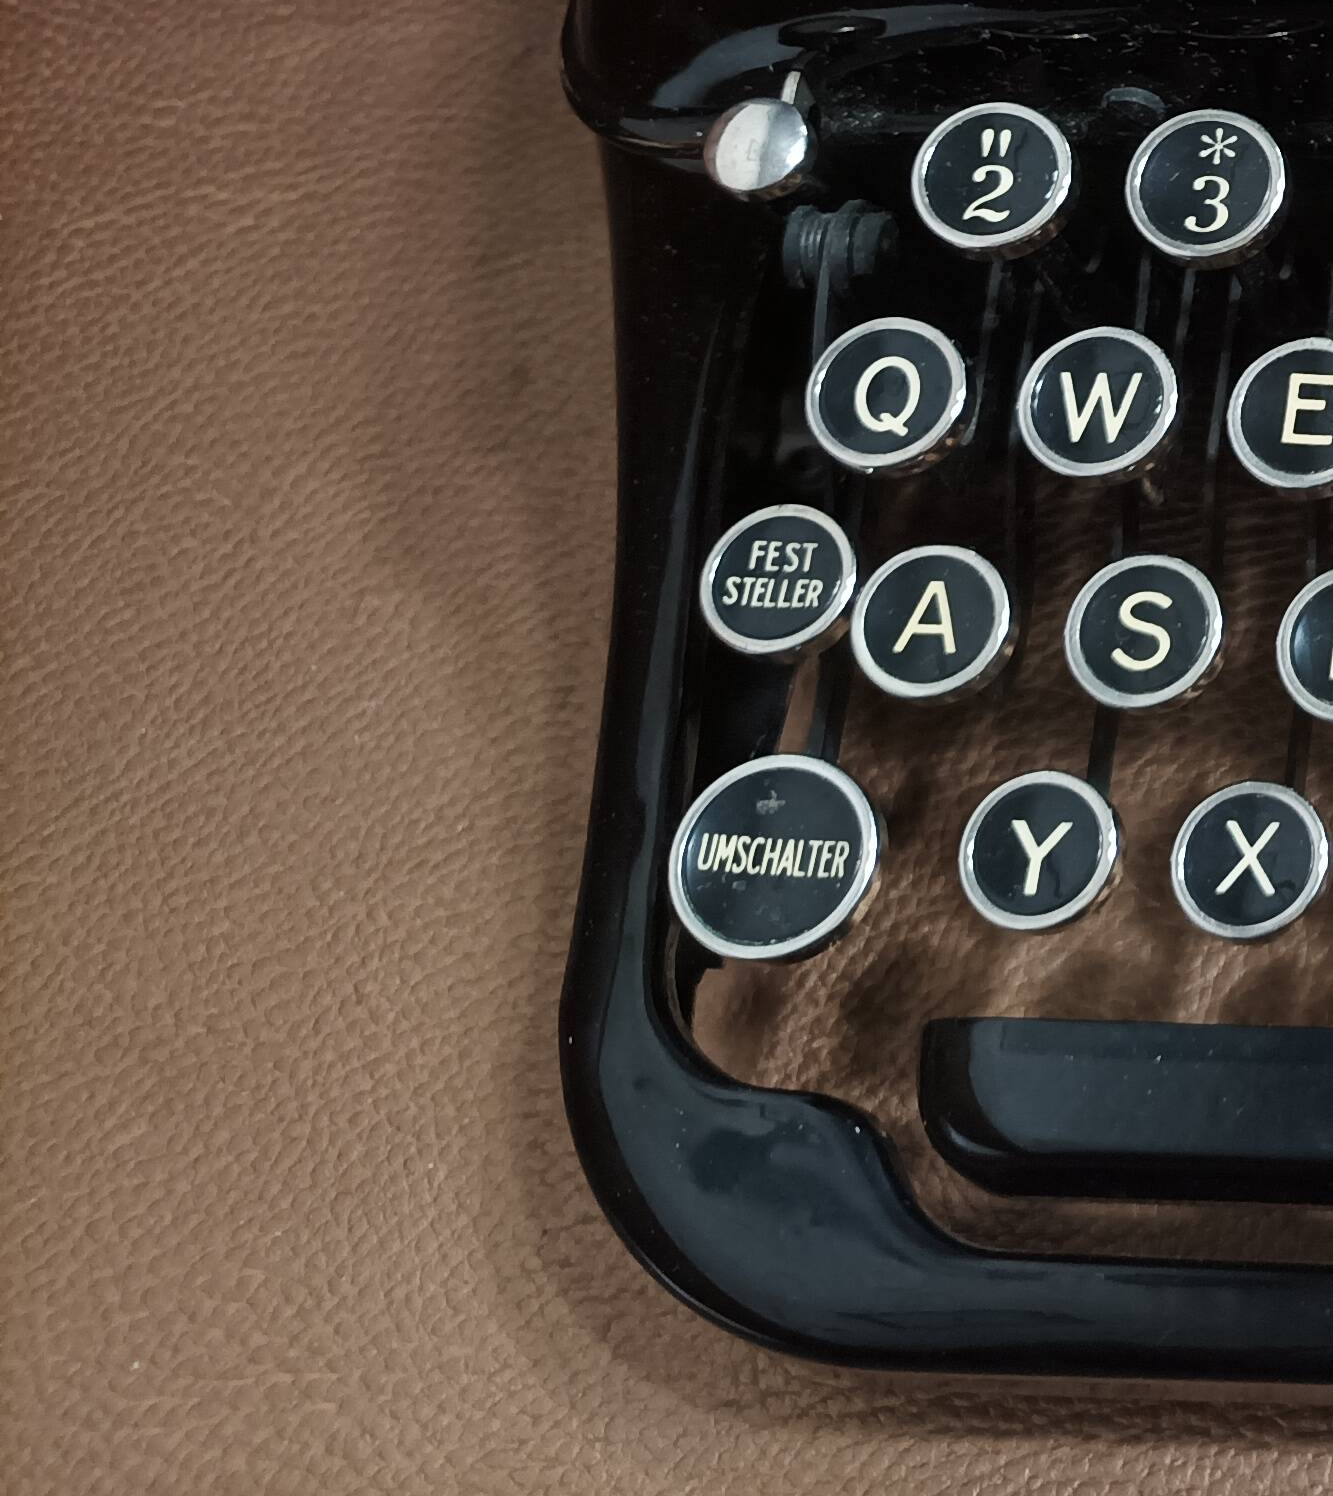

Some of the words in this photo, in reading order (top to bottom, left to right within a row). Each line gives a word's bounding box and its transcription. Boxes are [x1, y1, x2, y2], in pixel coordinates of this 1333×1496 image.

[963, 164, 1014, 223] 2
[1183, 175, 1230, 233] 3
[854, 356, 920, 437] Q
[1060, 371, 1142, 444] W
[722, 576, 823, 608] STELLER
[748, 540, 818, 573] FEST
[892, 580, 956, 654] A
[1111, 591, 1172, 671] S
[697, 833, 850, 879] UMSCHALTER
[1012, 819, 1073, 896] Y
[1215, 820, 1280, 897] X
